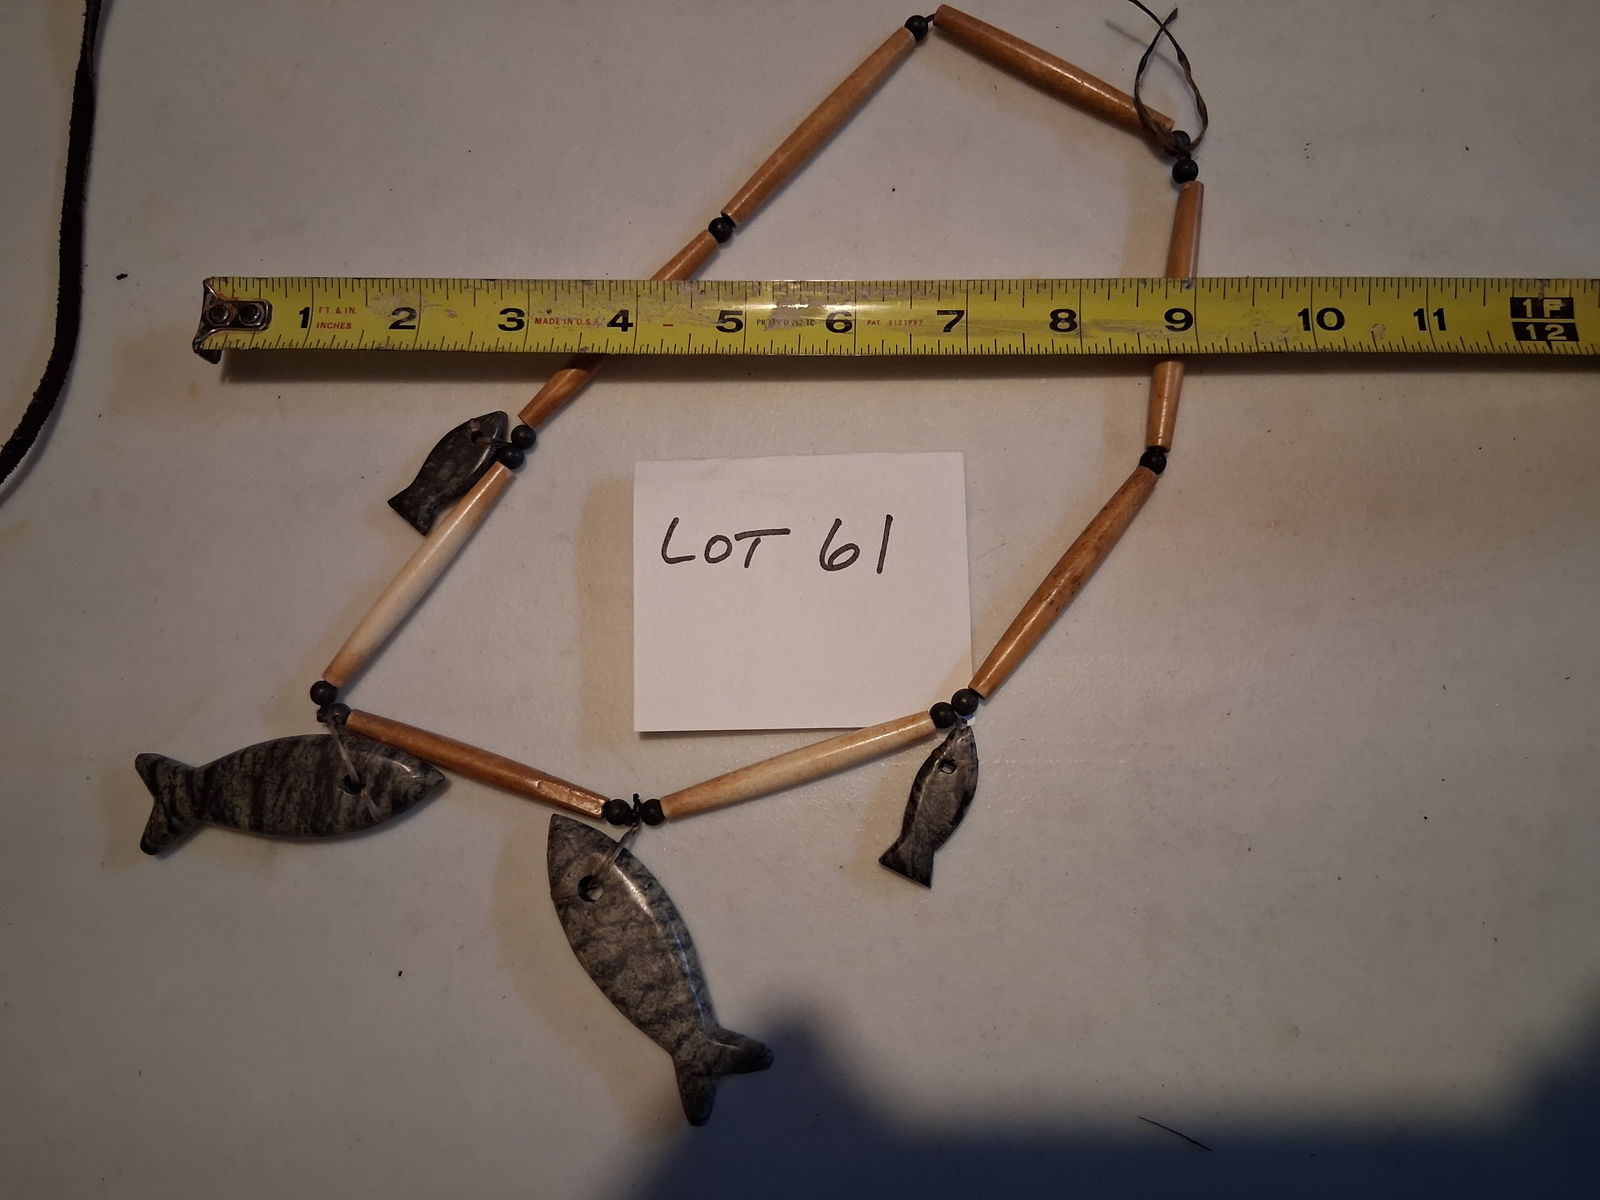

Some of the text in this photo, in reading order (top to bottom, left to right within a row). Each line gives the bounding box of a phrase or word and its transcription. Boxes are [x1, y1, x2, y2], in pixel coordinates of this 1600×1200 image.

[298, 306, 311, 329] 1
[335, 306, 342, 315] &
[388, 307, 417, 330] 2
[497, 308, 525, 332] 3
[534, 317, 560, 325] MADE
[562, 317, 573, 325] IN
[606, 309, 634, 333] 4
[715, 309, 744, 333] 5
[825, 309, 853, 334] 6
[936, 309, 966, 333] 7
[1048, 308, 1078, 333] 8
[1163, 307, 1194, 333] 9
[1297, 307, 1346, 332] 10
[1412, 307, 1447, 332] 11
[316, 322, 352, 330] INCHES
[1525, 323, 1567, 341] 12
[661, 514, 893, 574] LOT 61
